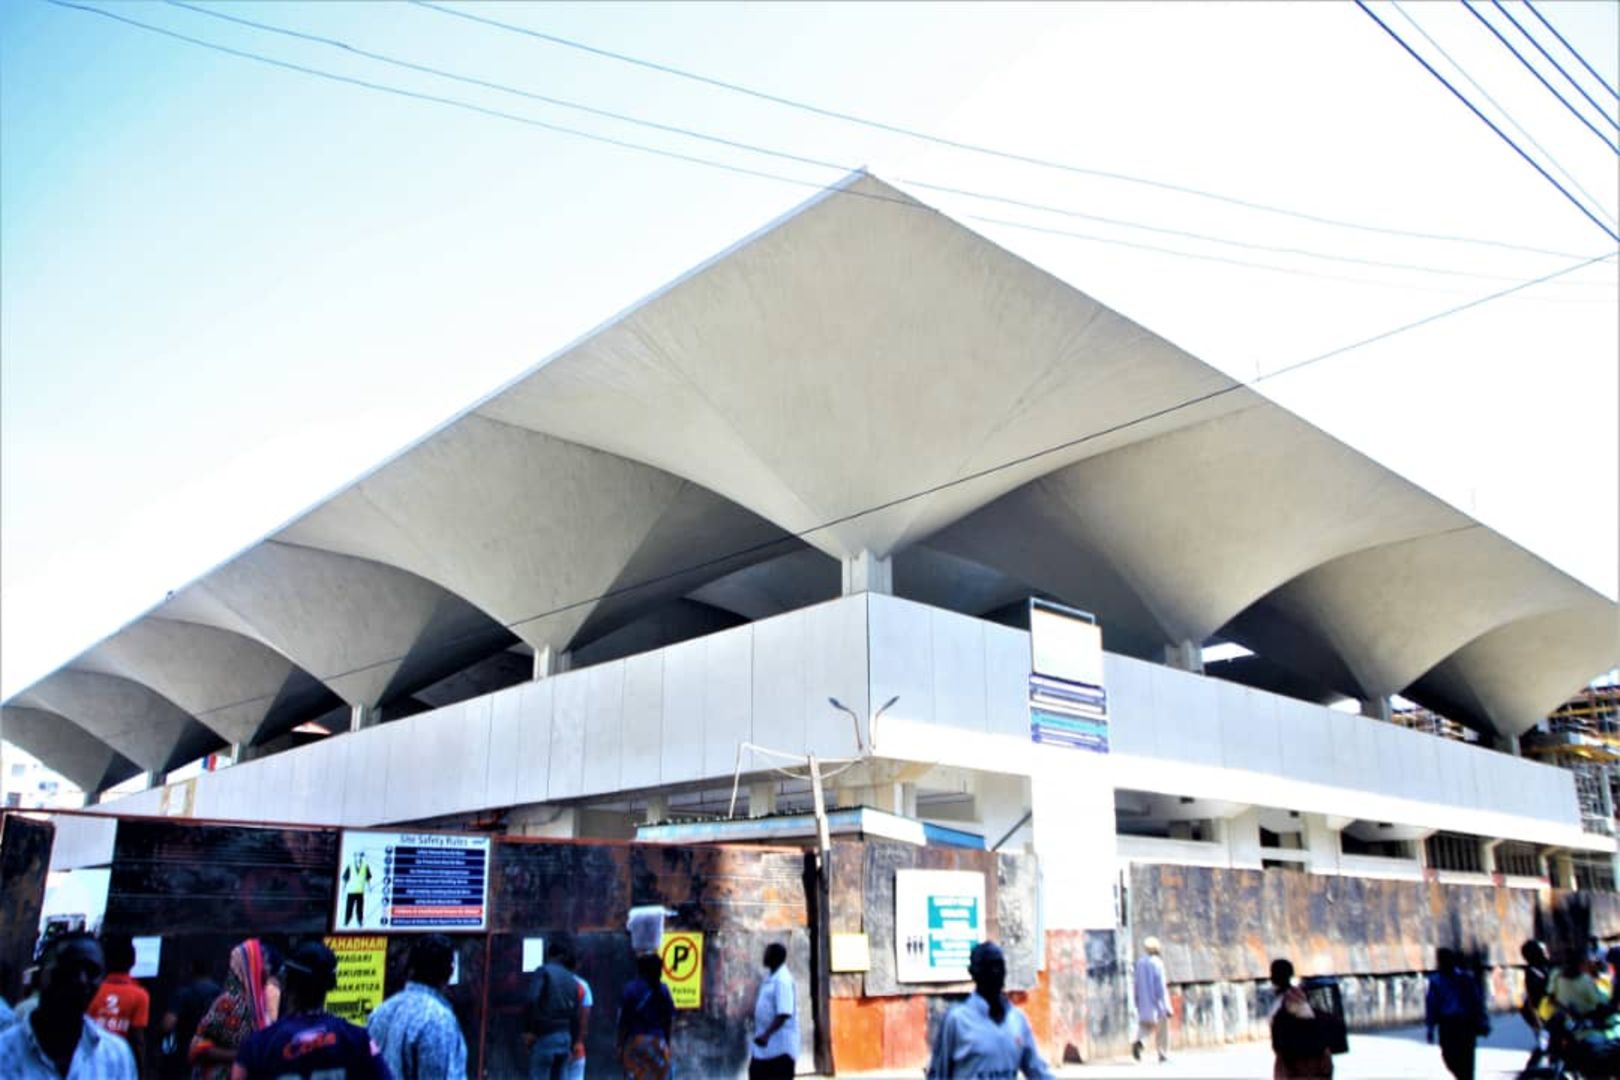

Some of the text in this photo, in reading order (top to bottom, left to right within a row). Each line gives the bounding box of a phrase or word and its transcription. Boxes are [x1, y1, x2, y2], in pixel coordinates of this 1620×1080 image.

[418, 835, 444, 847] Safety
[672, 946, 690, 972] P
[337, 969, 376, 977] AKUBWA
